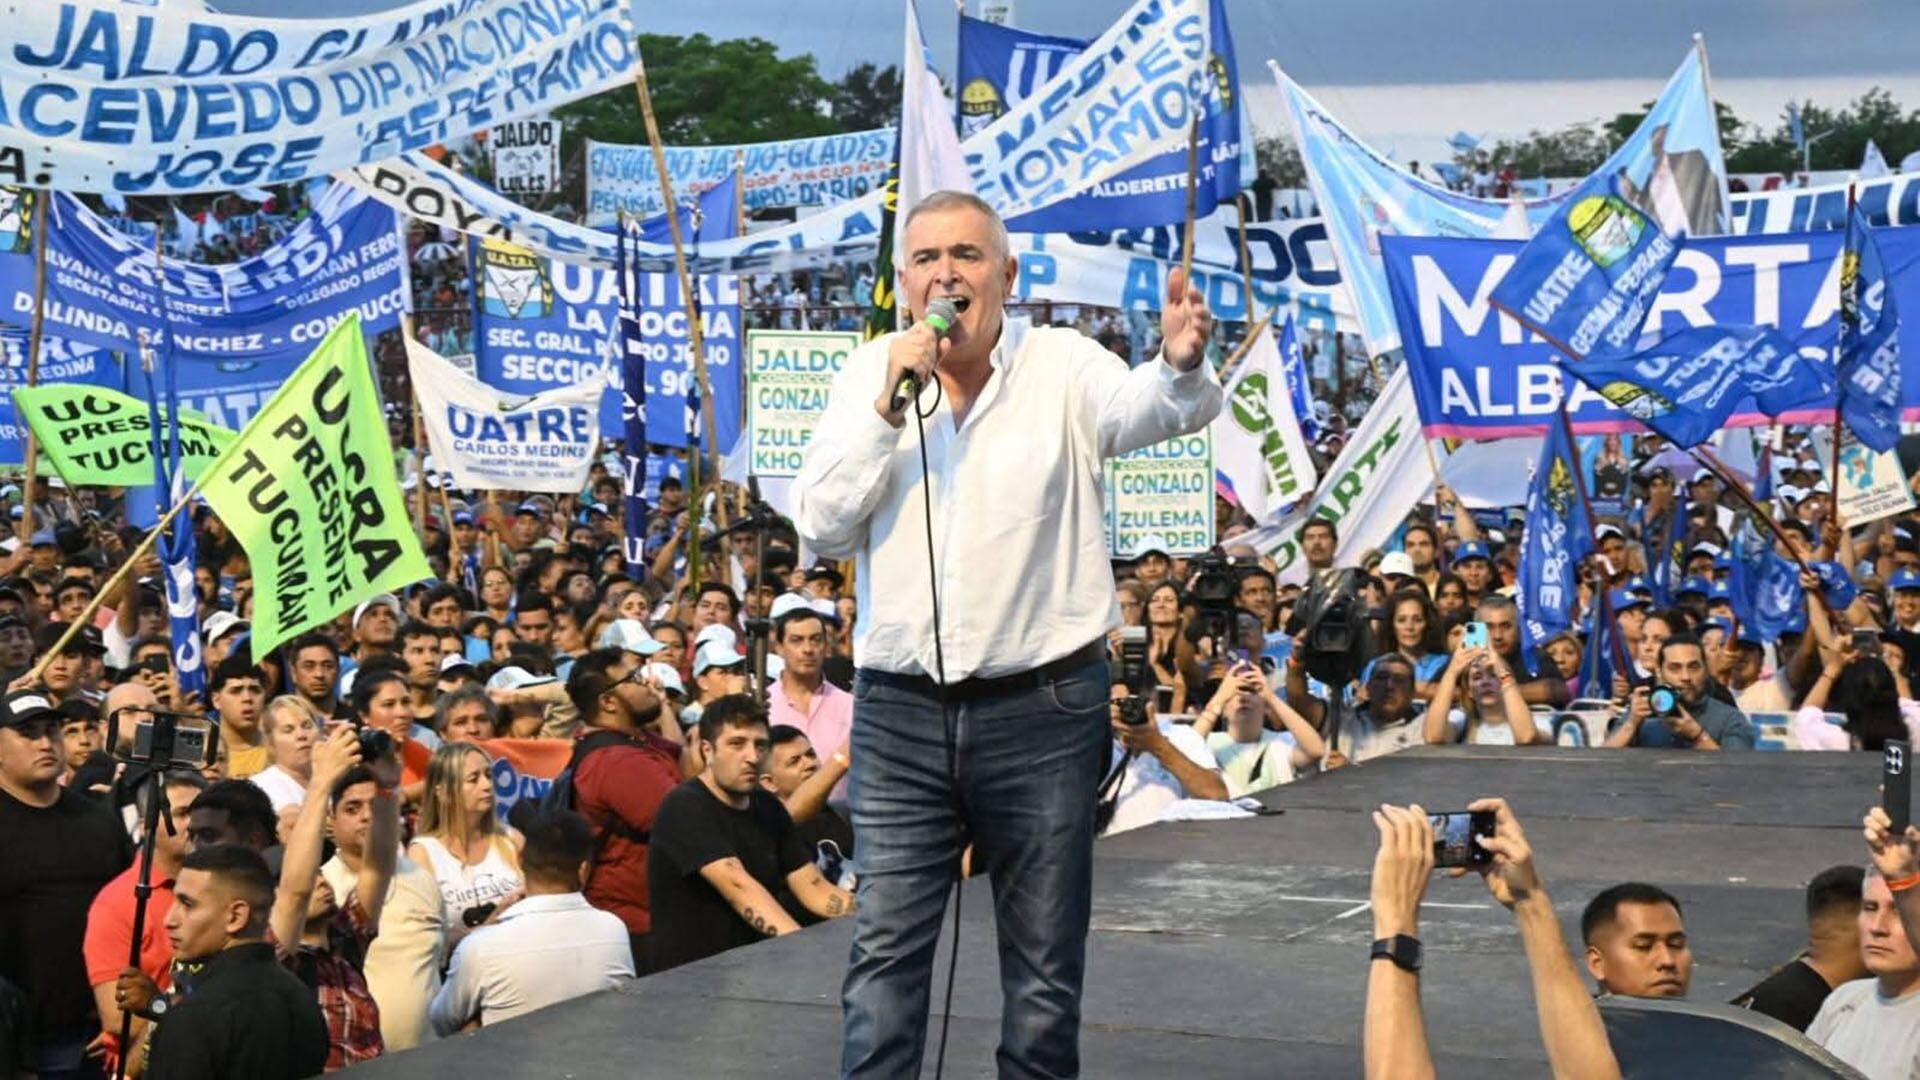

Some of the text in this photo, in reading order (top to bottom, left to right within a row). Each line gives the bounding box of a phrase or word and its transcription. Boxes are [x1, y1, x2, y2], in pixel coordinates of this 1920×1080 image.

[13, 3, 278, 81] JALDO
[113, 136, 324, 191] JOSE
[503, 17, 637, 112] RAMO
[493, 122, 552, 149] JALDO
[499, 174, 546, 192] LULES
[45, 247, 113, 289] ILVANA
[285, 275, 361, 309] DELEGADO
[1523, 249, 1595, 325] UATRE
[566, 306, 607, 334] LA
[487, 328, 531, 349] SEC.
[535, 331, 591, 354] GRAL.
[756, 349, 849, 372] JALDO
[447, 403, 590, 443] UATRE
[453, 439, 519, 457] CARLOS
[757, 428, 813, 446] ZULE
[1119, 436, 1206, 459] ALDO
[756, 452, 803, 470] KHO
[1121, 473, 1204, 495] GONZALO
[1119, 511, 1205, 528] ZULEMA
[1119, 531, 1207, 550] KDER
